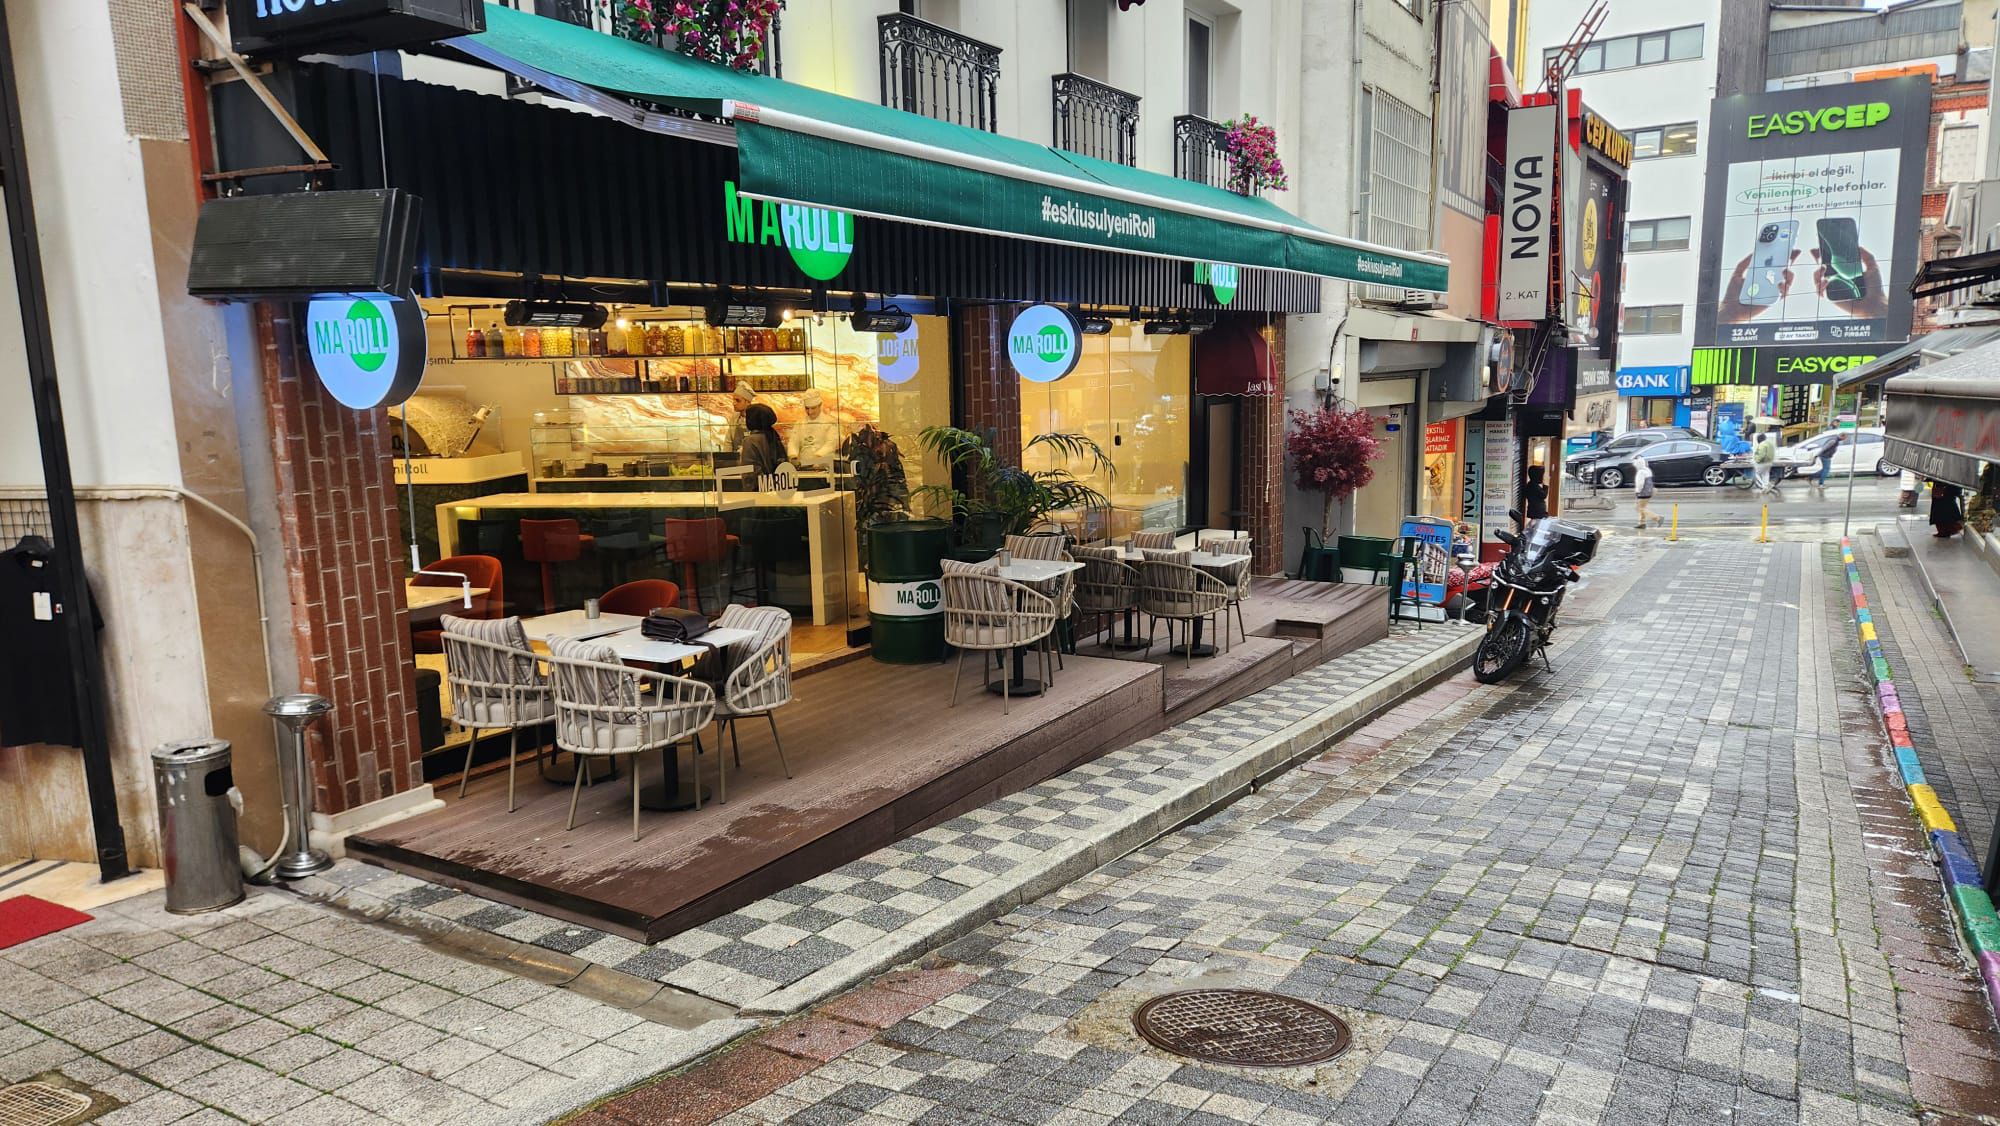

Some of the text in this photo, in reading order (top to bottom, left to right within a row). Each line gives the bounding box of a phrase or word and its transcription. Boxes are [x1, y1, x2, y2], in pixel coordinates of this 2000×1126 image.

[1747, 102, 1891, 138] EASYCEP
[1808, 167, 1820, 178] el
[1743, 180, 1886, 201] Yenilenmiş telefonlar.
[1041, 195, 1155, 239] #eskiusulyeniRoll
[1510, 155, 1544, 259] NOVA
[1518, 290, 1539, 300] KAT
[1731, 327, 1759, 336] 12 AY
[758, 471, 799, 492] MAROLL
[897, 588, 941, 604] MAROLL
